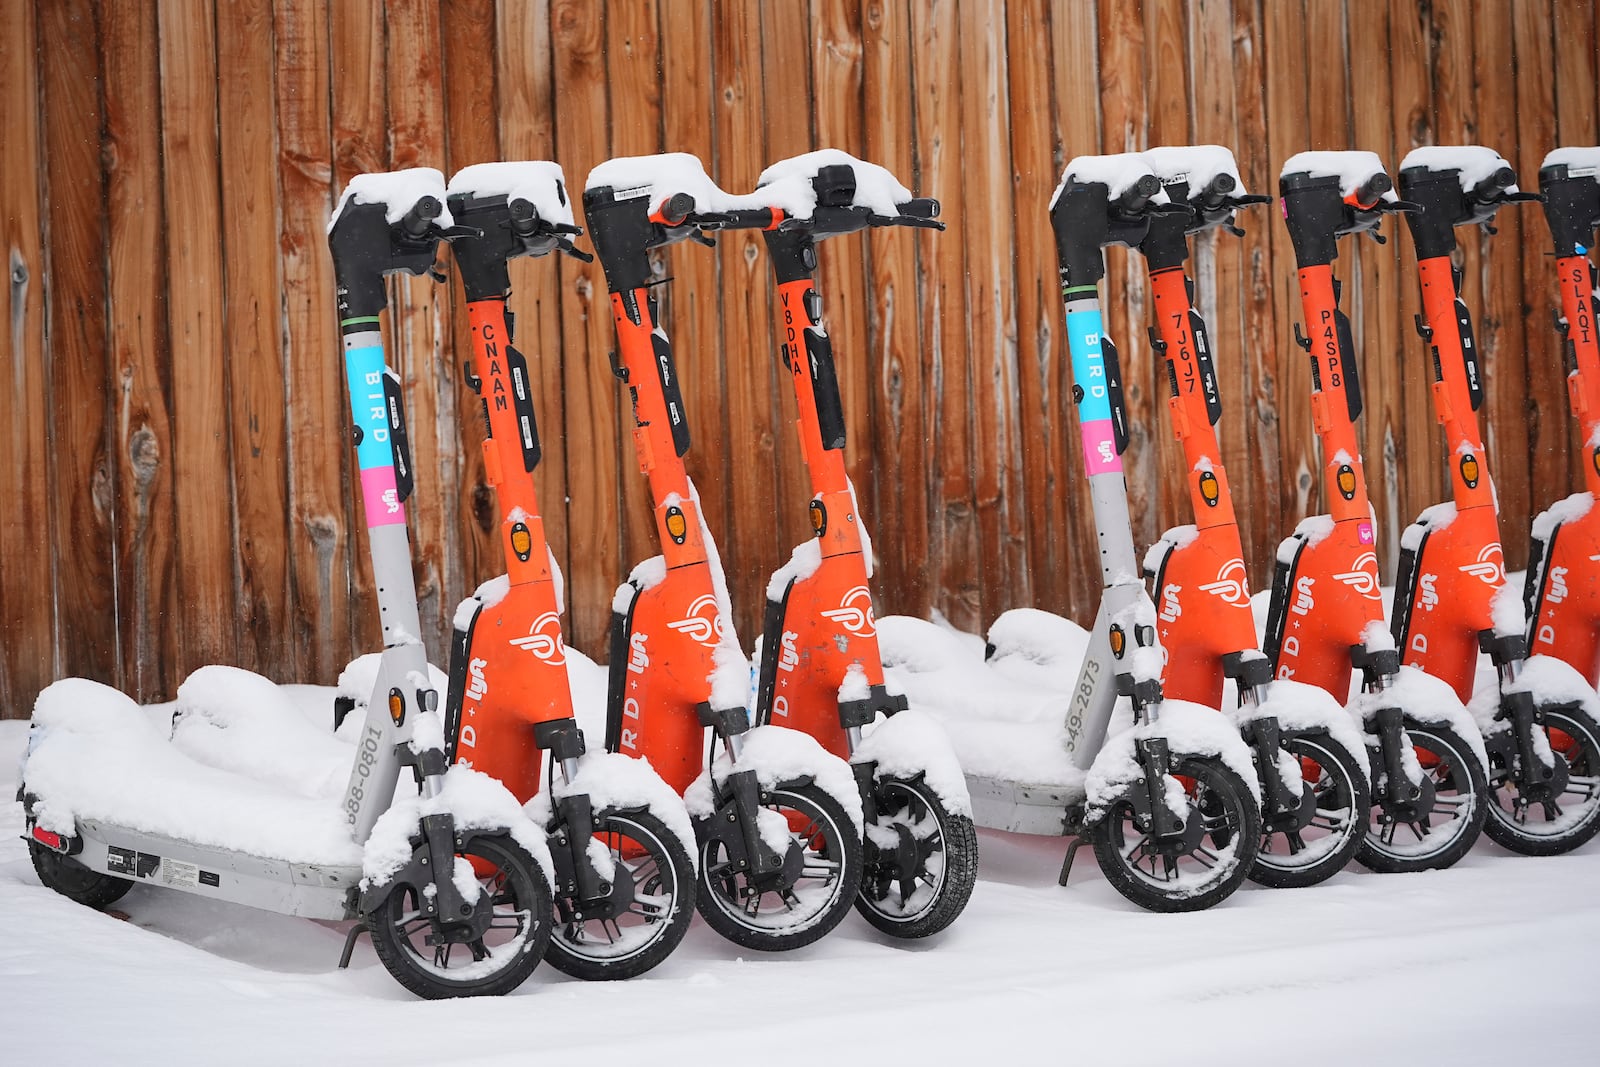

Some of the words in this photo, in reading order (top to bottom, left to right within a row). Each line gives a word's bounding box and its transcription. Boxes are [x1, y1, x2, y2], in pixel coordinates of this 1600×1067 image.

[781, 292, 802, 376] V8DHA
[1571, 269, 1590, 343] SLAQI
[482, 324, 508, 412] CNAAM
[1084, 332, 1105, 398] BIRD
[1171, 313, 1195, 393] 7J6J7
[1321, 310, 1341, 387] P4SP8
[365, 369, 388, 442] BIRD
[1159, 583, 1182, 623] lyft
[1291, 575, 1316, 616] lyft
[1546, 566, 1569, 604] lyft
[465, 657, 488, 701] lyft
[627, 631, 650, 675] lyft
[778, 630, 800, 673] lyft
